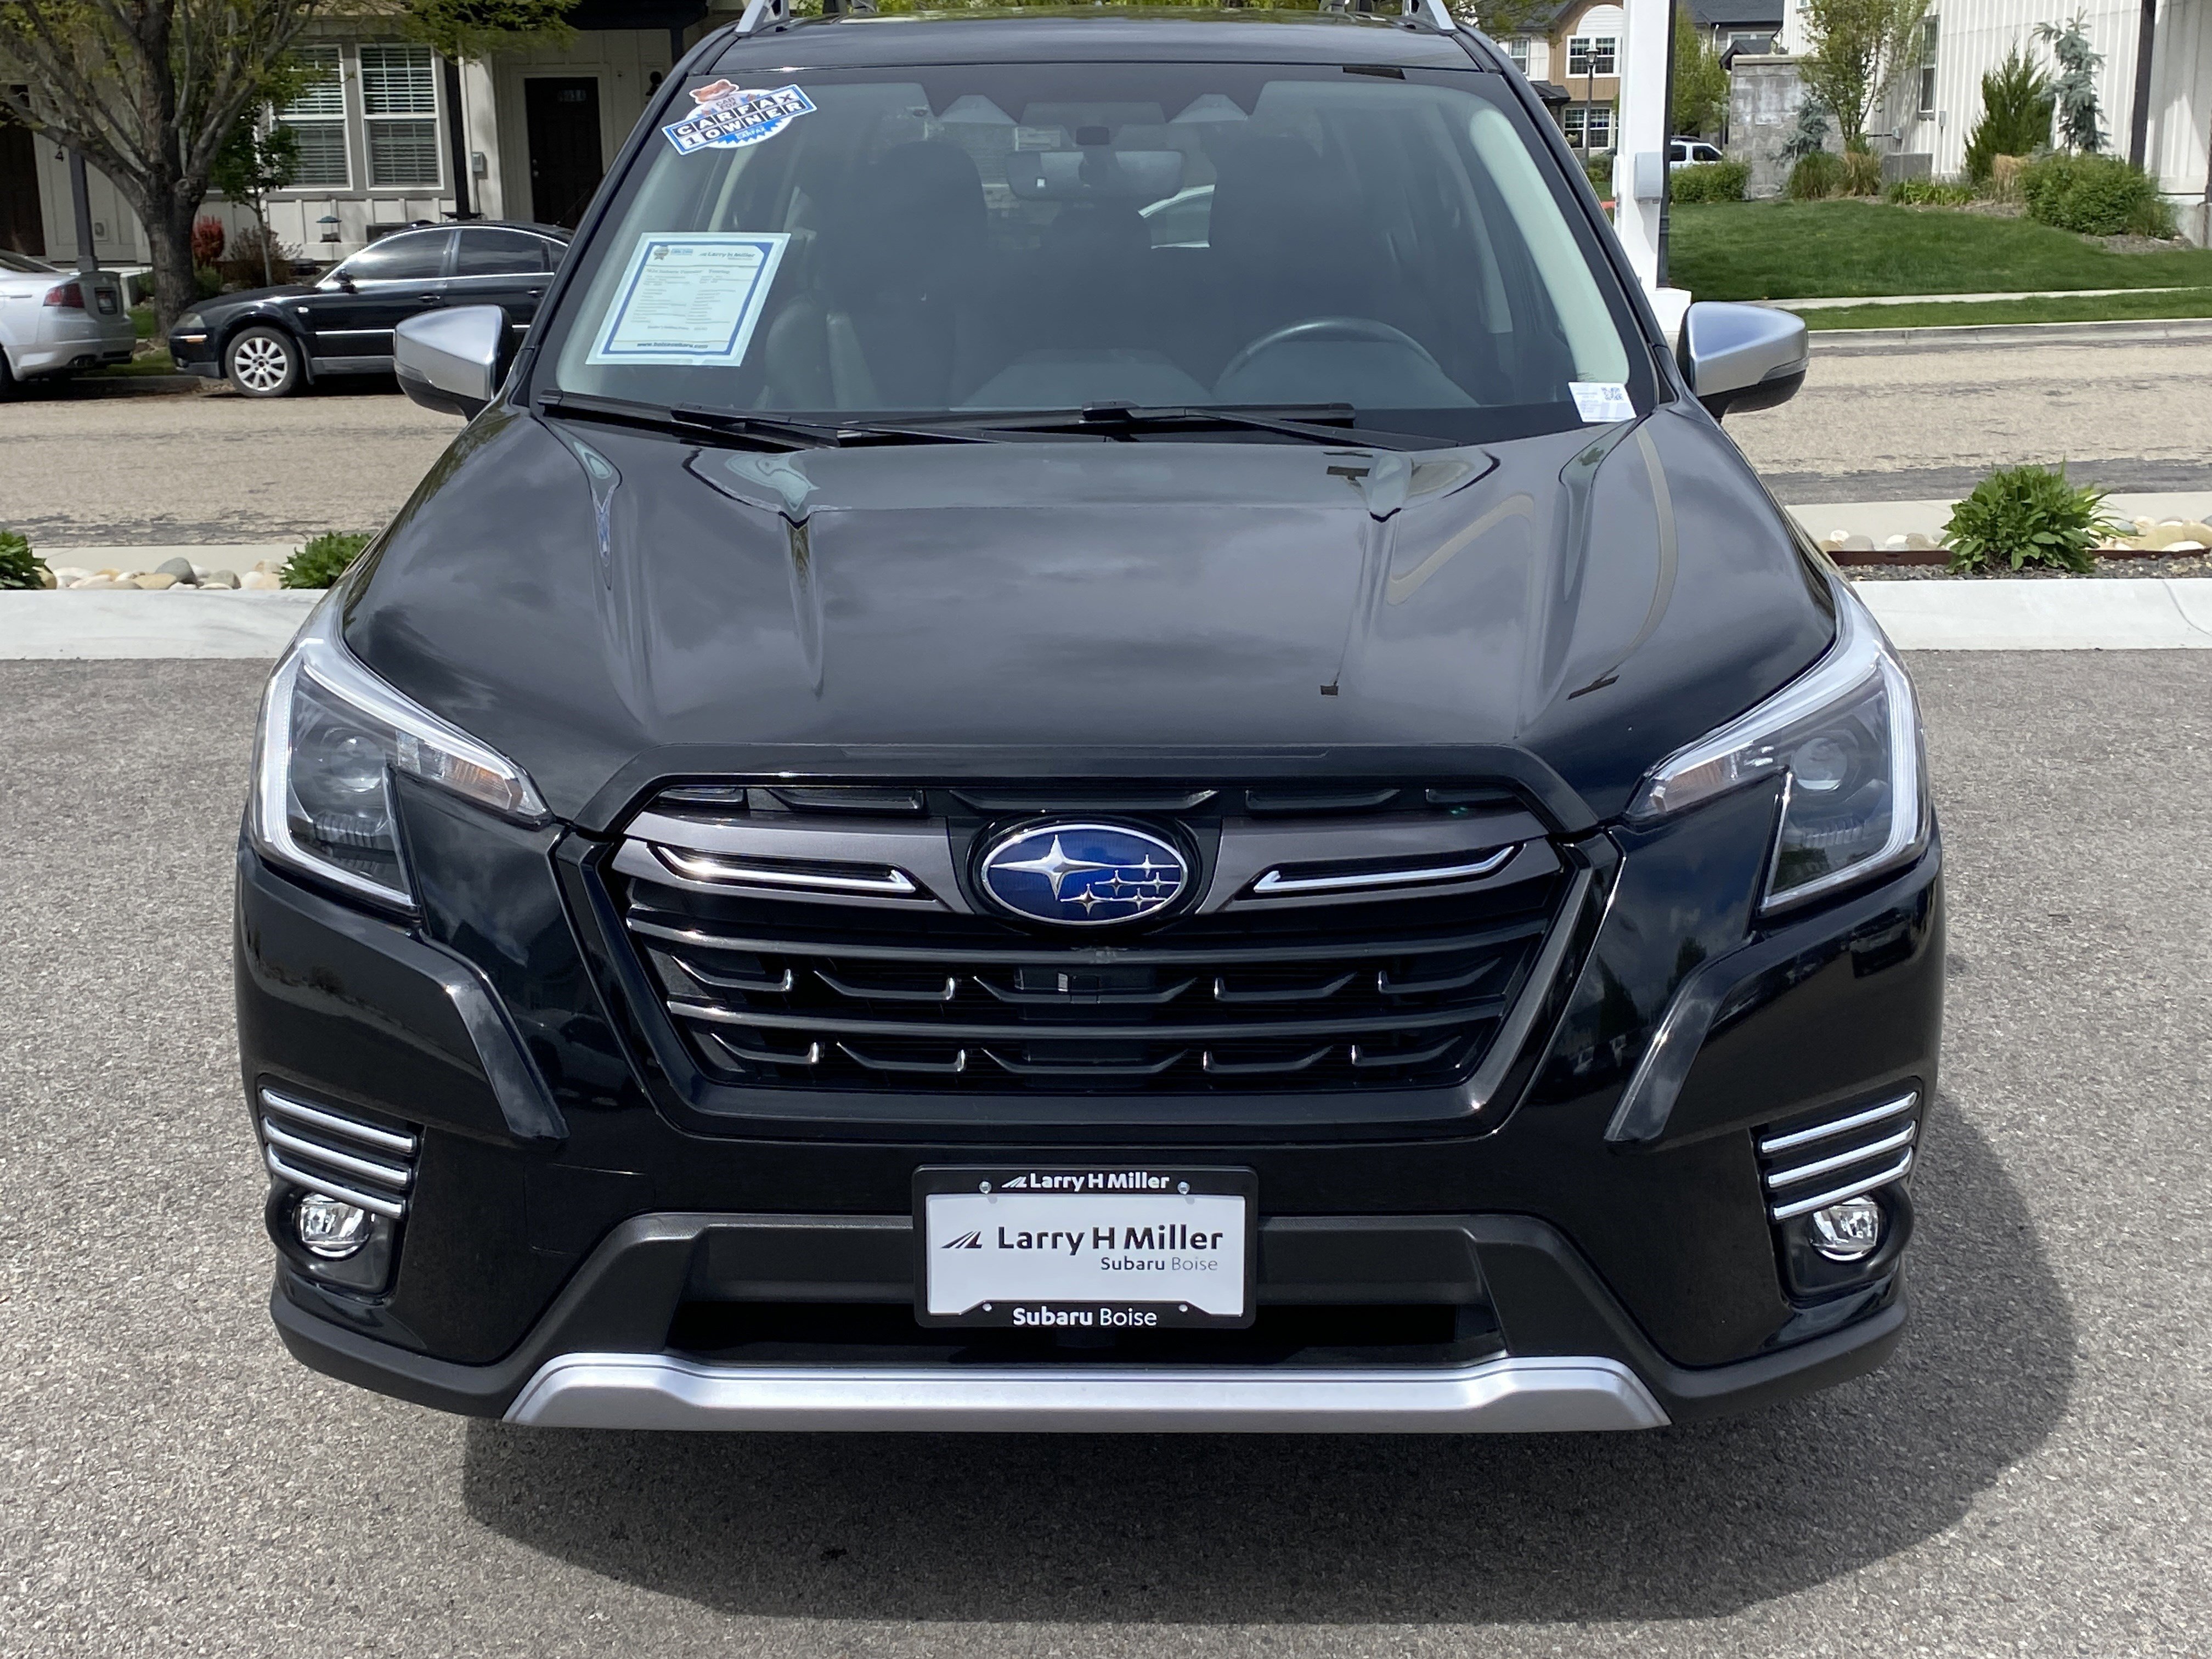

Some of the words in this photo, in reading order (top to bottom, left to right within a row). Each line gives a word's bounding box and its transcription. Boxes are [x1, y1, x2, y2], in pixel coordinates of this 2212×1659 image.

[676, 93, 793, 136] CARFAX
[684, 135, 700, 146] 1
[704, 103, 803, 139] OWNER
[1030, 1172, 1085, 1192] Larry
[1088, 1173, 1104, 1189] H
[1107, 1172, 1170, 1189] Miller
[998, 1226, 1085, 1256] Larry
[1093, 1227, 1115, 1250] H
[1123, 1223, 1223, 1250] Miller
[1101, 1256, 1165, 1271] Subaru
[1171, 1256, 1218, 1271] Boise
[1013, 1306, 1093, 1326] Subaru
[1099, 1307, 1158, 1327] Boise
